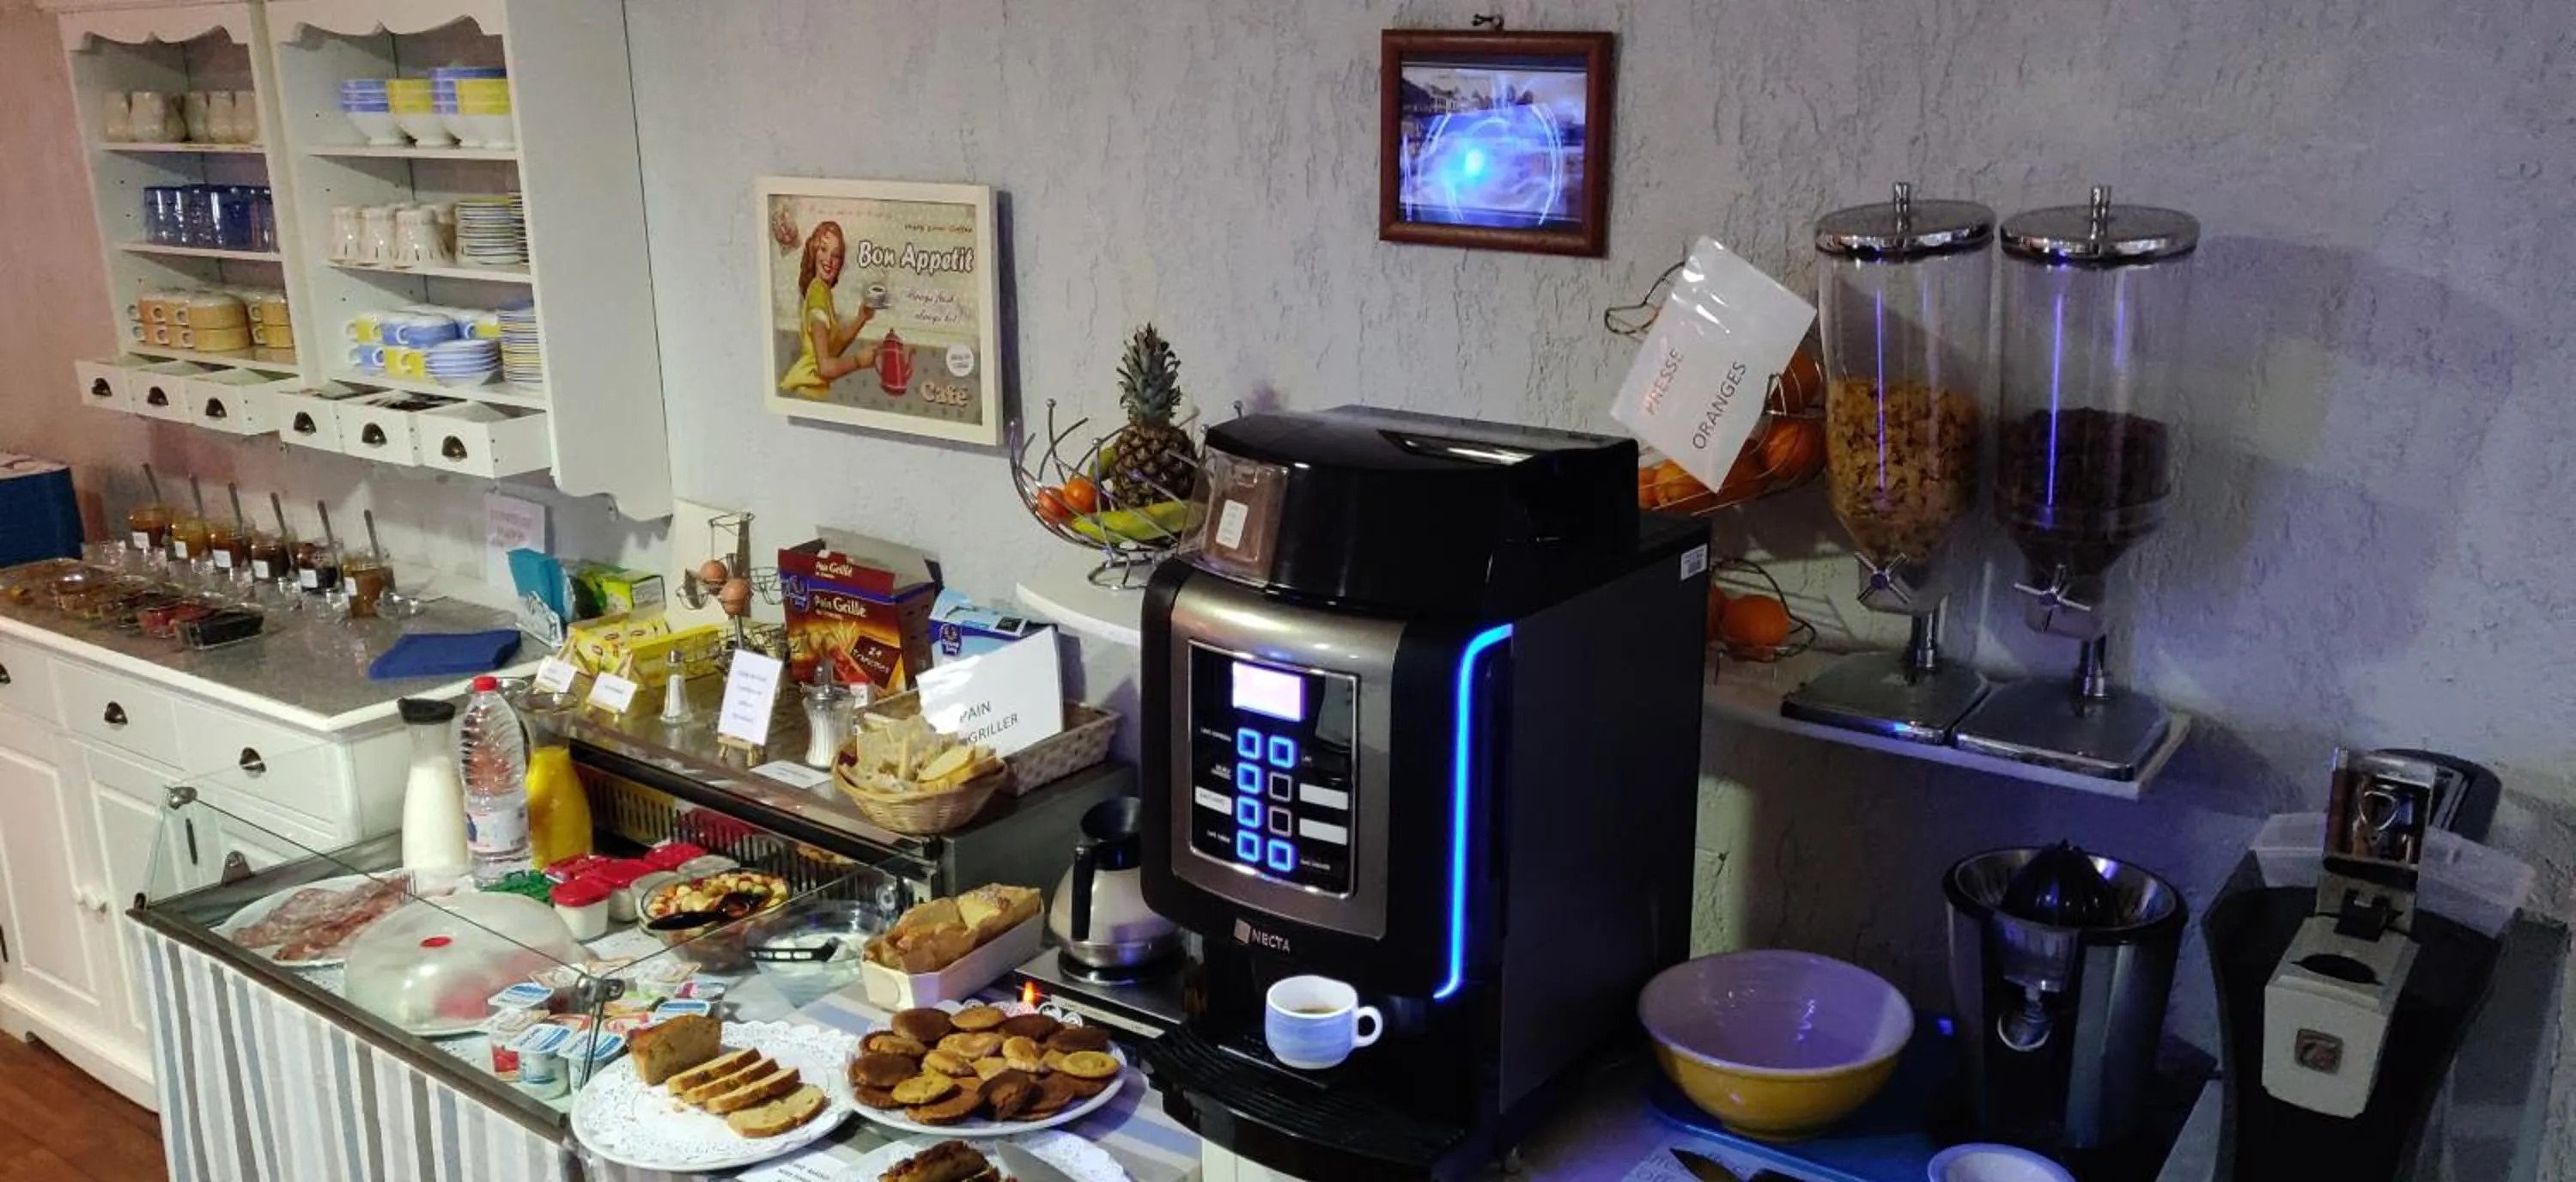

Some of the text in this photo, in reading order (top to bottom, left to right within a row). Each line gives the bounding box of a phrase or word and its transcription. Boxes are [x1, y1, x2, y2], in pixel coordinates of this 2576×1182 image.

[857, 241, 975, 276] Bon Appetit
[1692, 359, 1747, 449] ORANGES
[968, 713, 1018, 744] GRILLER
[1252, 929, 1290, 954] NECTA
